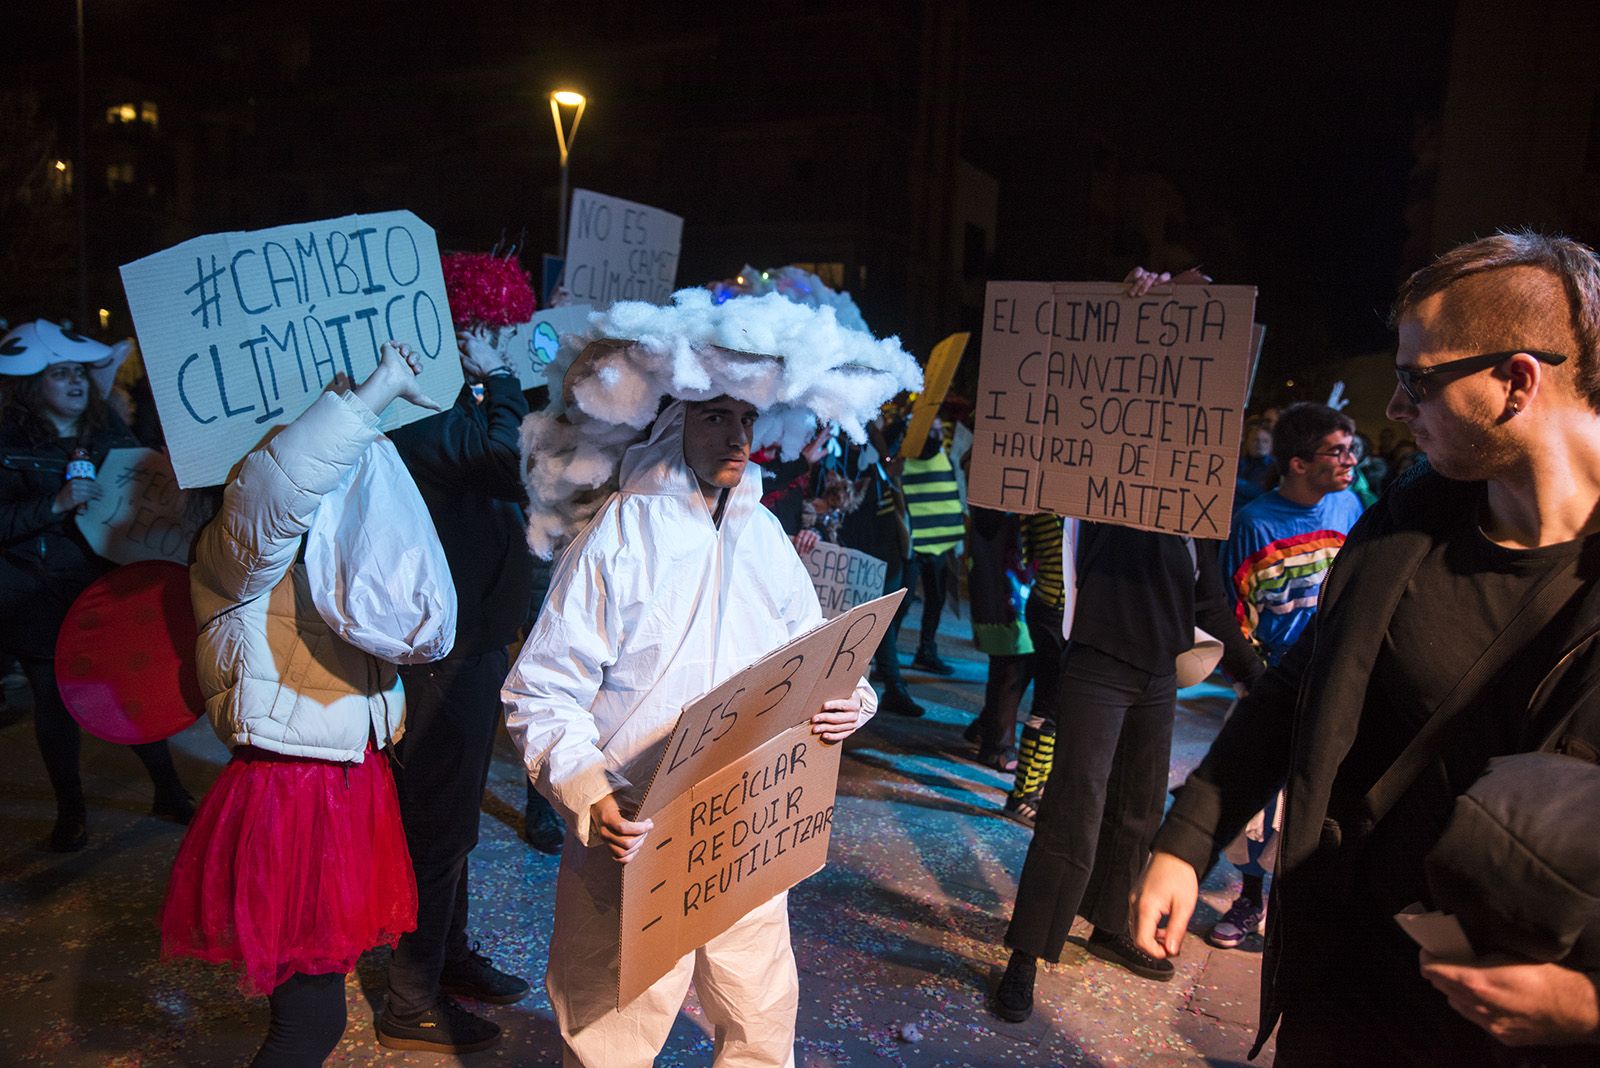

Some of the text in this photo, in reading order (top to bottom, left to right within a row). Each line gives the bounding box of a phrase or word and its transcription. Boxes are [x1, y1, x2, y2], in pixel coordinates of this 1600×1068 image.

[578, 198, 648, 245] NO ES
[184, 225, 420, 328] #CAMBIO
[993, 288, 1226, 347] EL CLIMA ESTÀ
[1017, 351, 1215, 401] CANVIANT
[985, 391, 1234, 447] I LA SOCIETAT
[992, 432, 1225, 487] HAURIA DE FER
[1001, 467, 1219, 534] AL MATEIX
[810, 548, 887, 590] SABEMOS
[814, 583, 881, 612] TENEM
[667, 613, 877, 775] LES 3 R
[687, 786, 803, 872] REDUIR
[683, 806, 834, 916] REUTILITZAR
